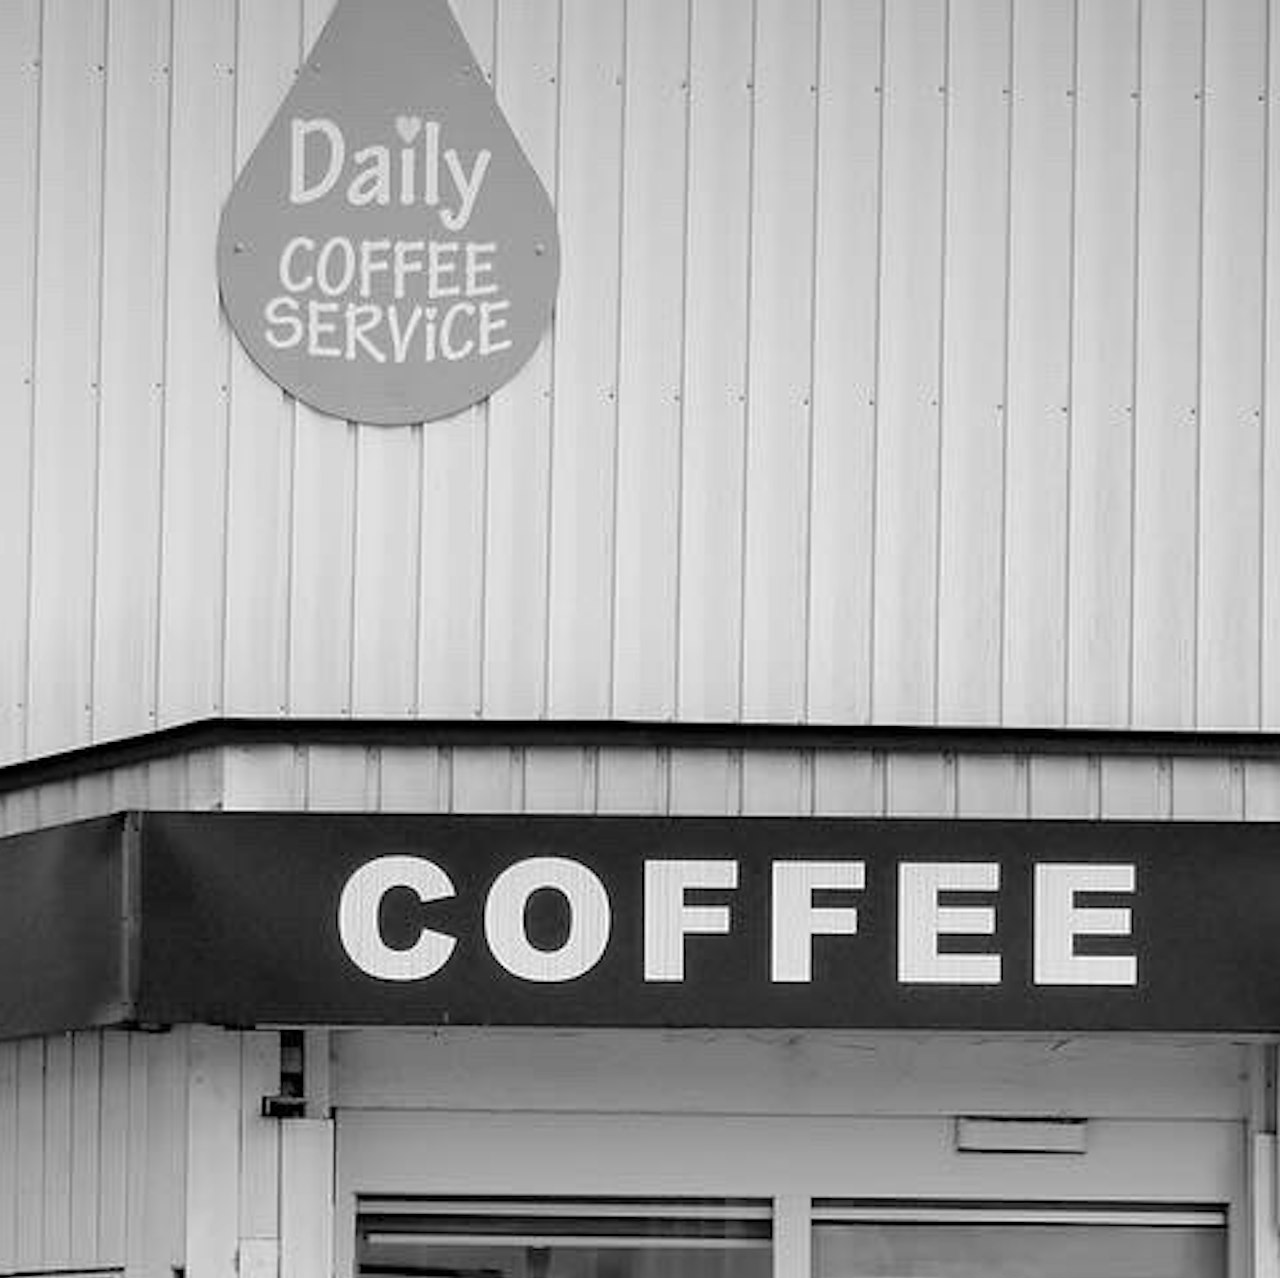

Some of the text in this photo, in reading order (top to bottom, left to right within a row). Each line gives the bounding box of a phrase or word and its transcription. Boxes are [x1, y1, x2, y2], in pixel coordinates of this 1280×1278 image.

[289, 115, 492, 232] Daily
[278, 236, 499, 300] COFFEE
[337, 853, 1139, 986] COFFEE
